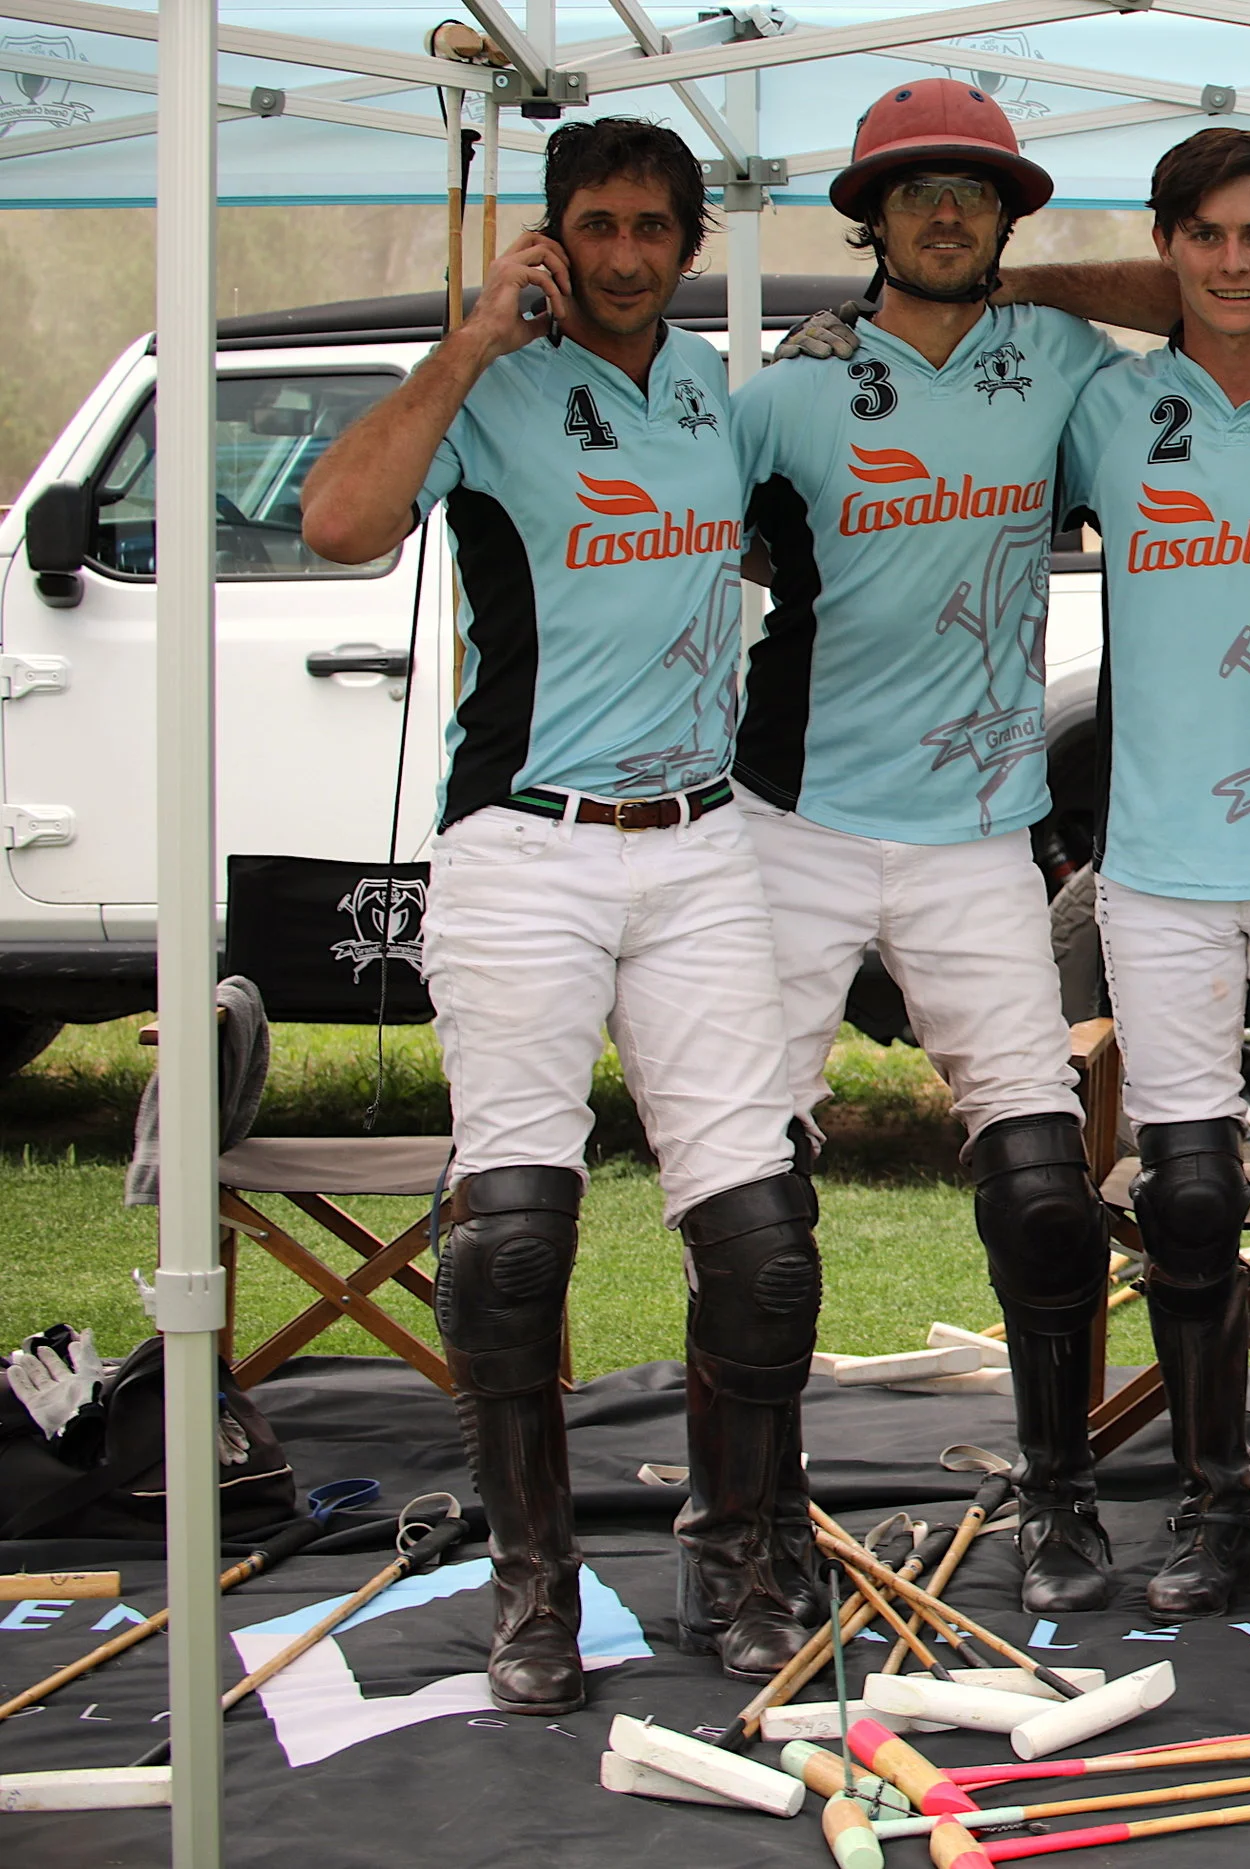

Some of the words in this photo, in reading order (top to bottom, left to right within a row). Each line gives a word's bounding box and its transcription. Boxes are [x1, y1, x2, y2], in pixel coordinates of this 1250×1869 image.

[564, 384, 618, 451] 4
[848, 358, 898, 421] 3
[1147, 395, 1193, 464] 2
[839, 474, 1048, 537] Casablanca
[985, 716, 1036, 749] Grand
